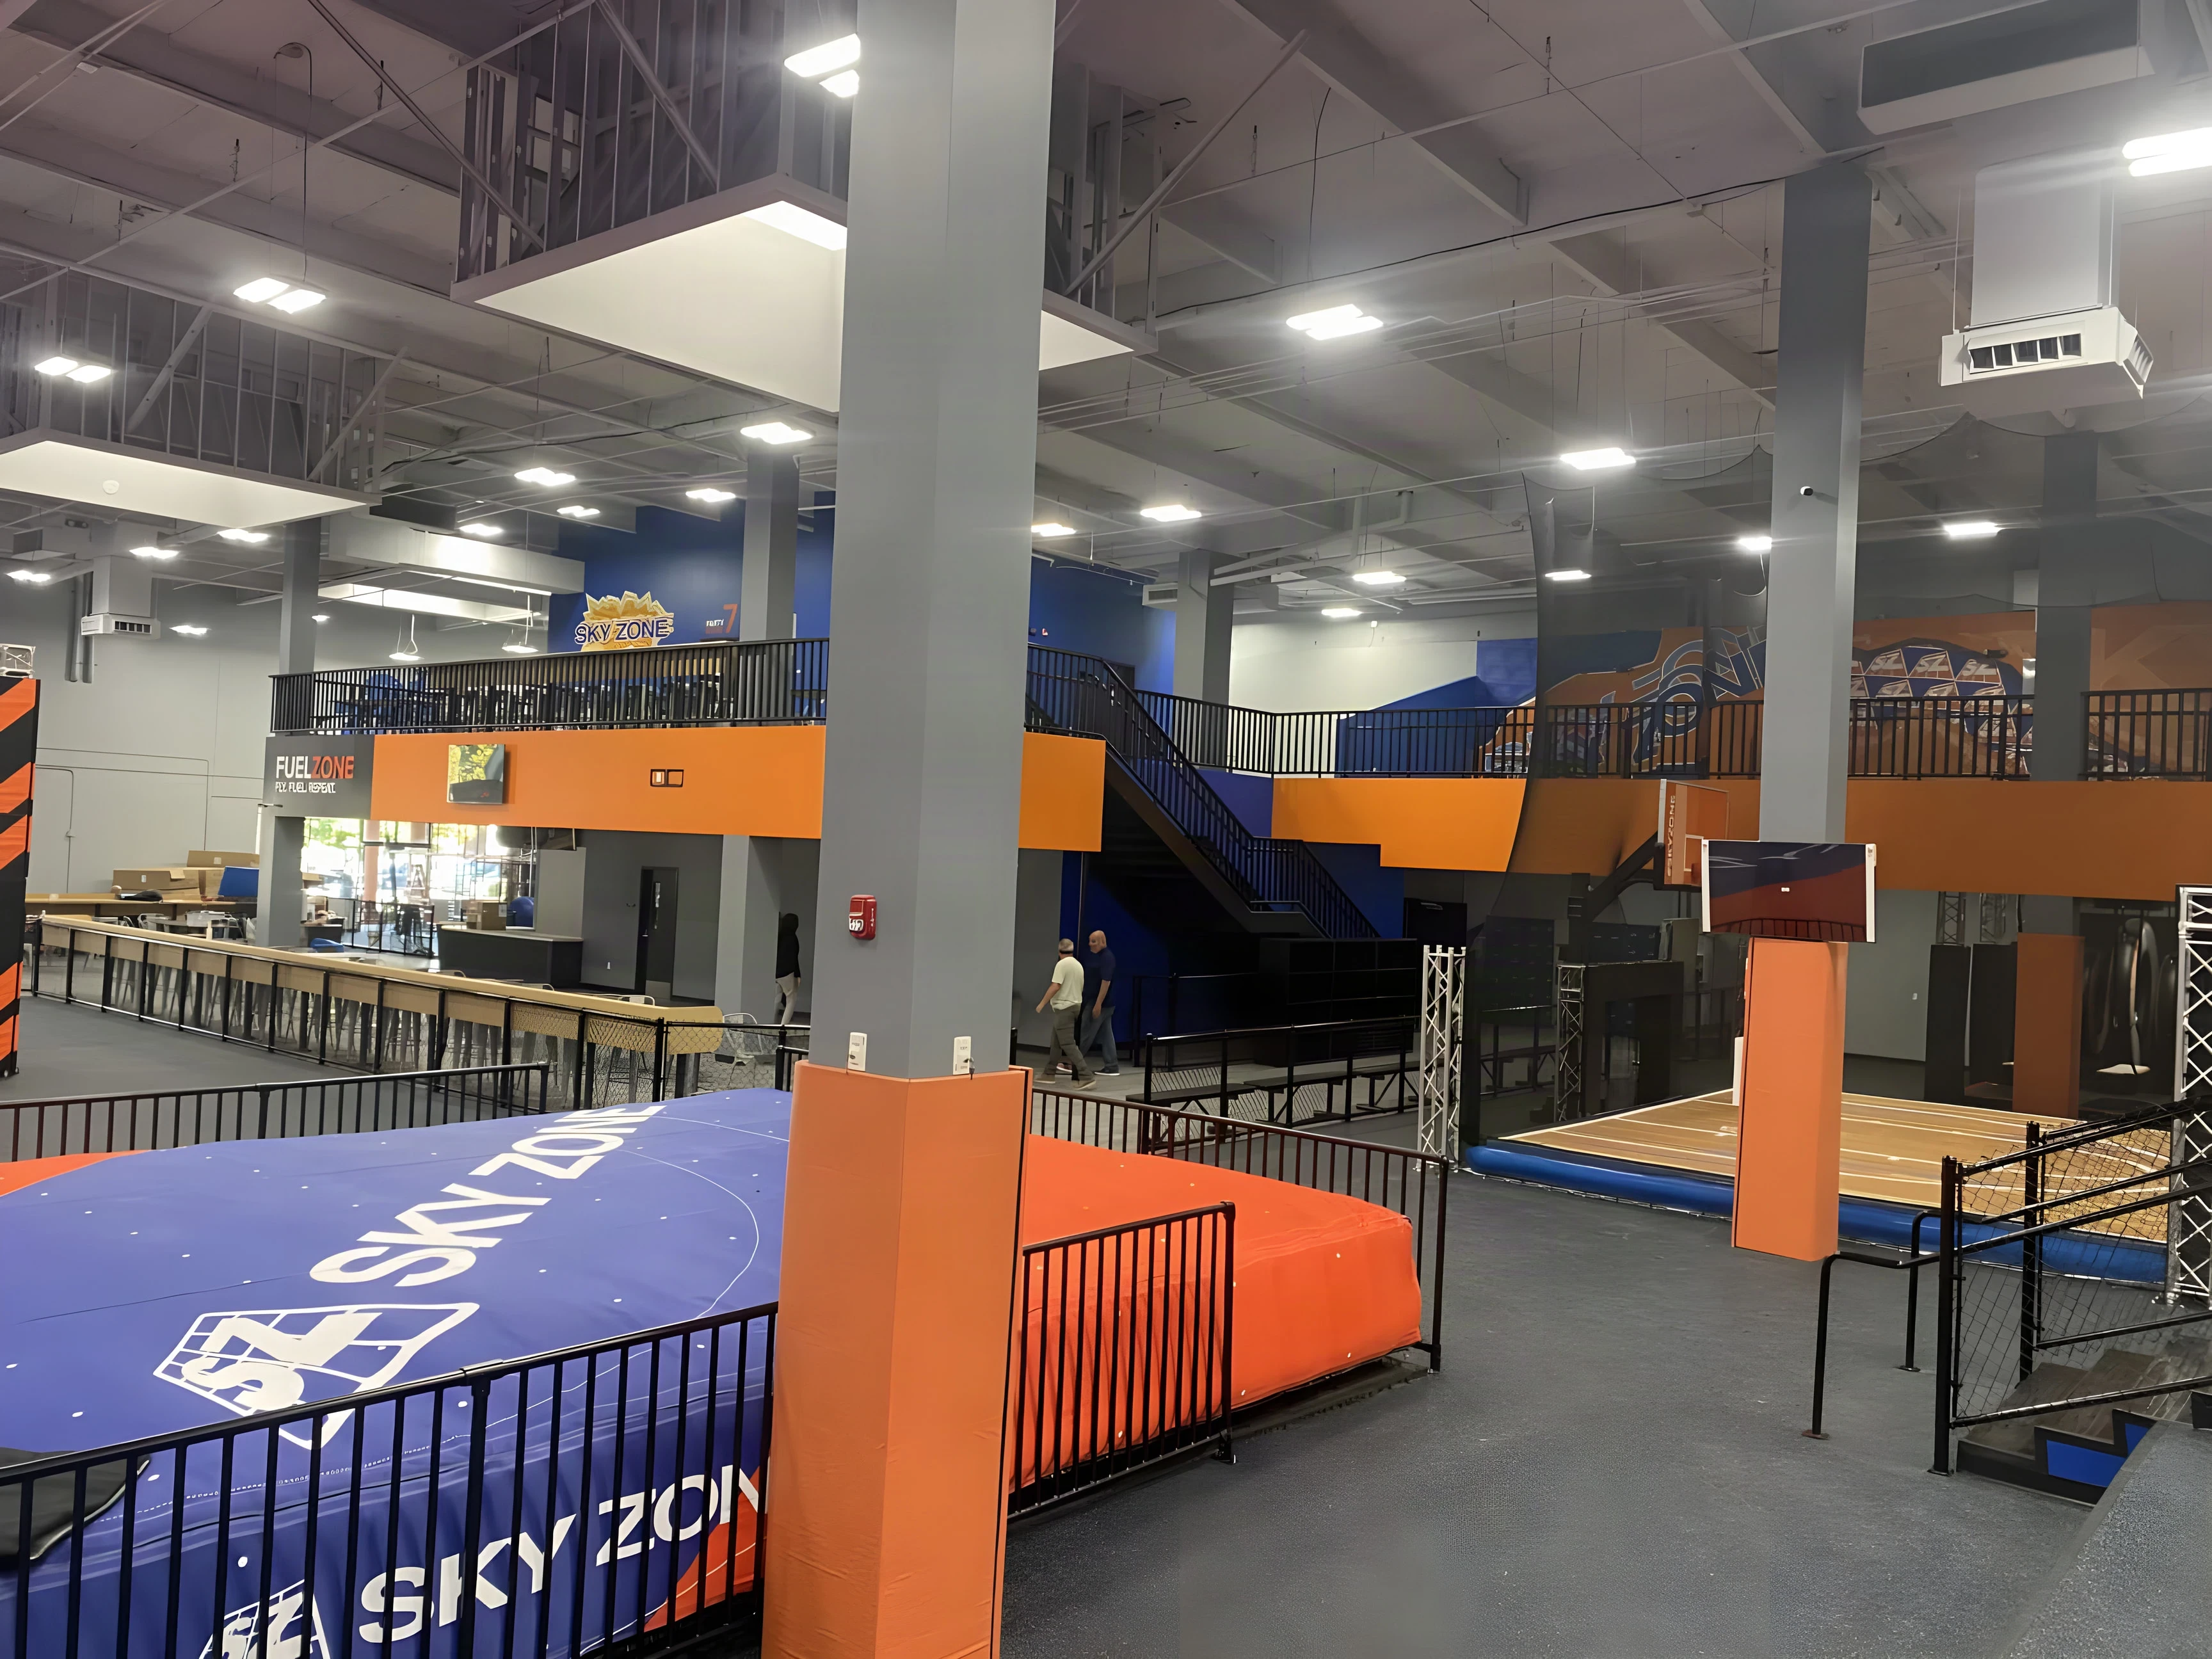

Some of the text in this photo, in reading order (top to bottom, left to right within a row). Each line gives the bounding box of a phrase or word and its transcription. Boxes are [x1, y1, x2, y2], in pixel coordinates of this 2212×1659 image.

[575, 619, 669, 644] SKY ZONE
[723, 604, 737, 633] 7
[309, 1105, 667, 1287] SKY ZONE
[358, 1513, 577, 1644] SKY
